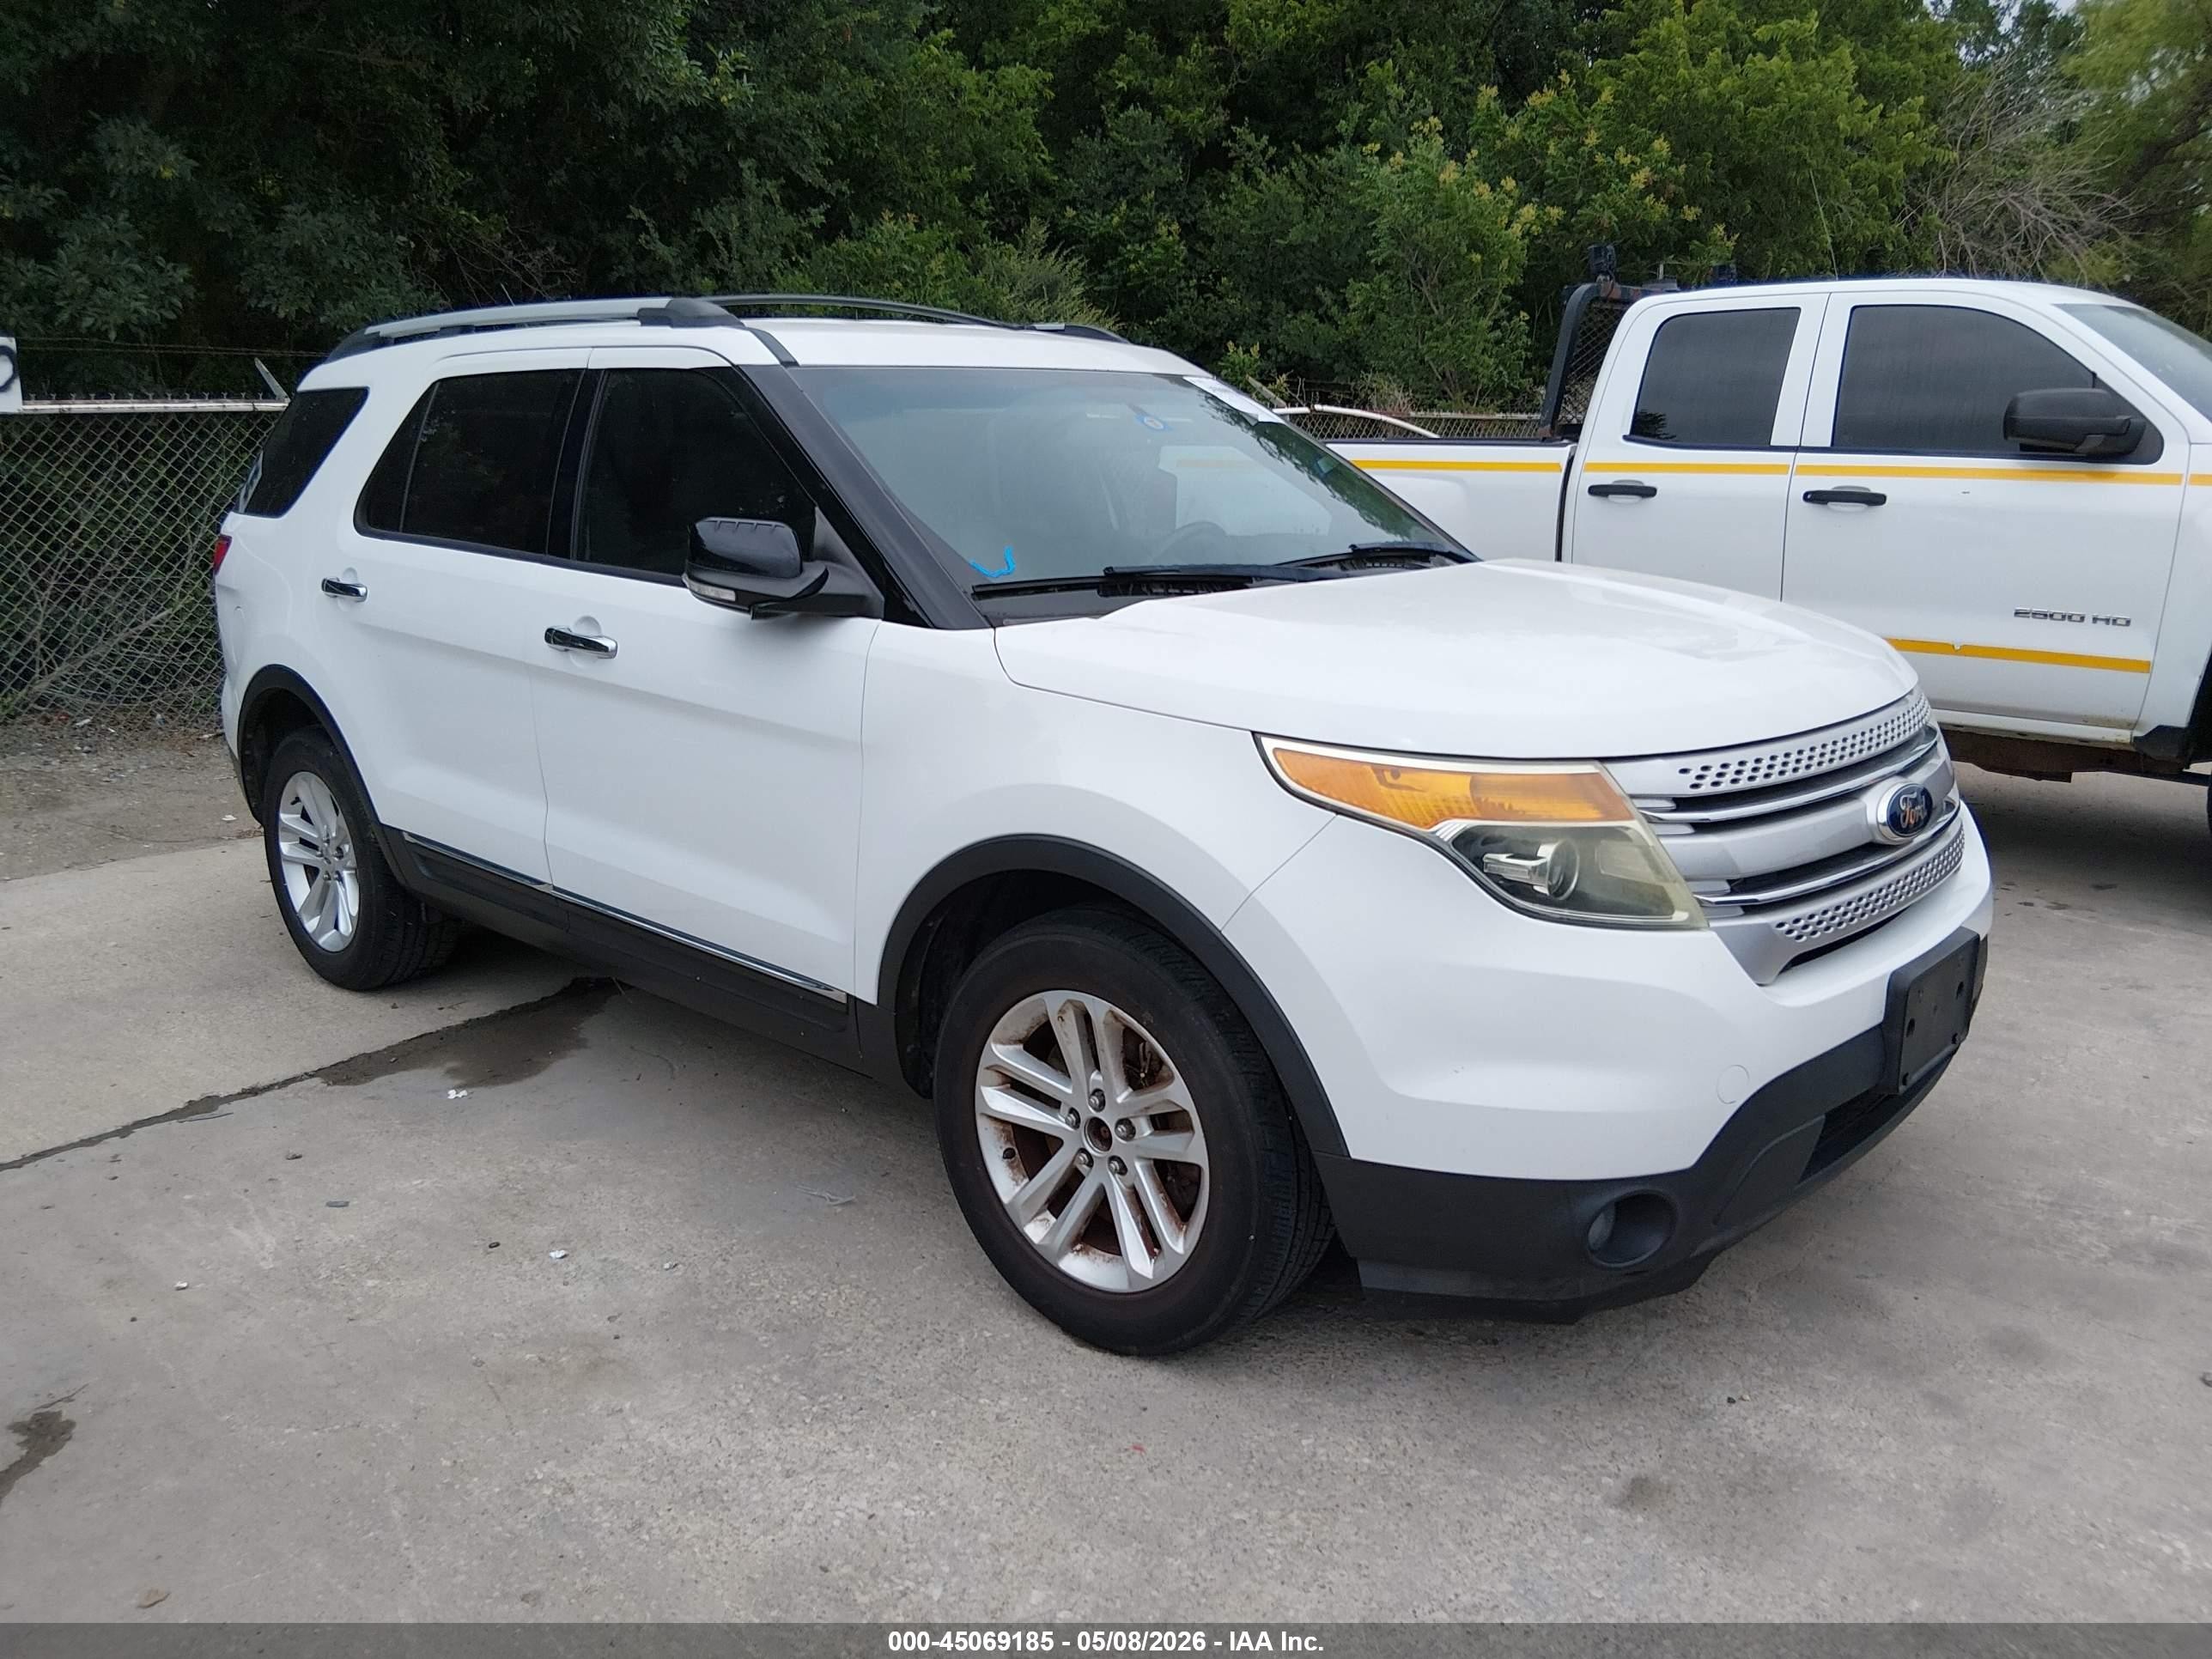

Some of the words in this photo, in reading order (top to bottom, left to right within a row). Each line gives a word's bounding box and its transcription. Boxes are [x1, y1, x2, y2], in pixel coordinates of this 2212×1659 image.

[2014, 606, 2086, 623] 2500
[2092, 613, 2131, 627] HD
[1899, 791, 1928, 829] Ford
